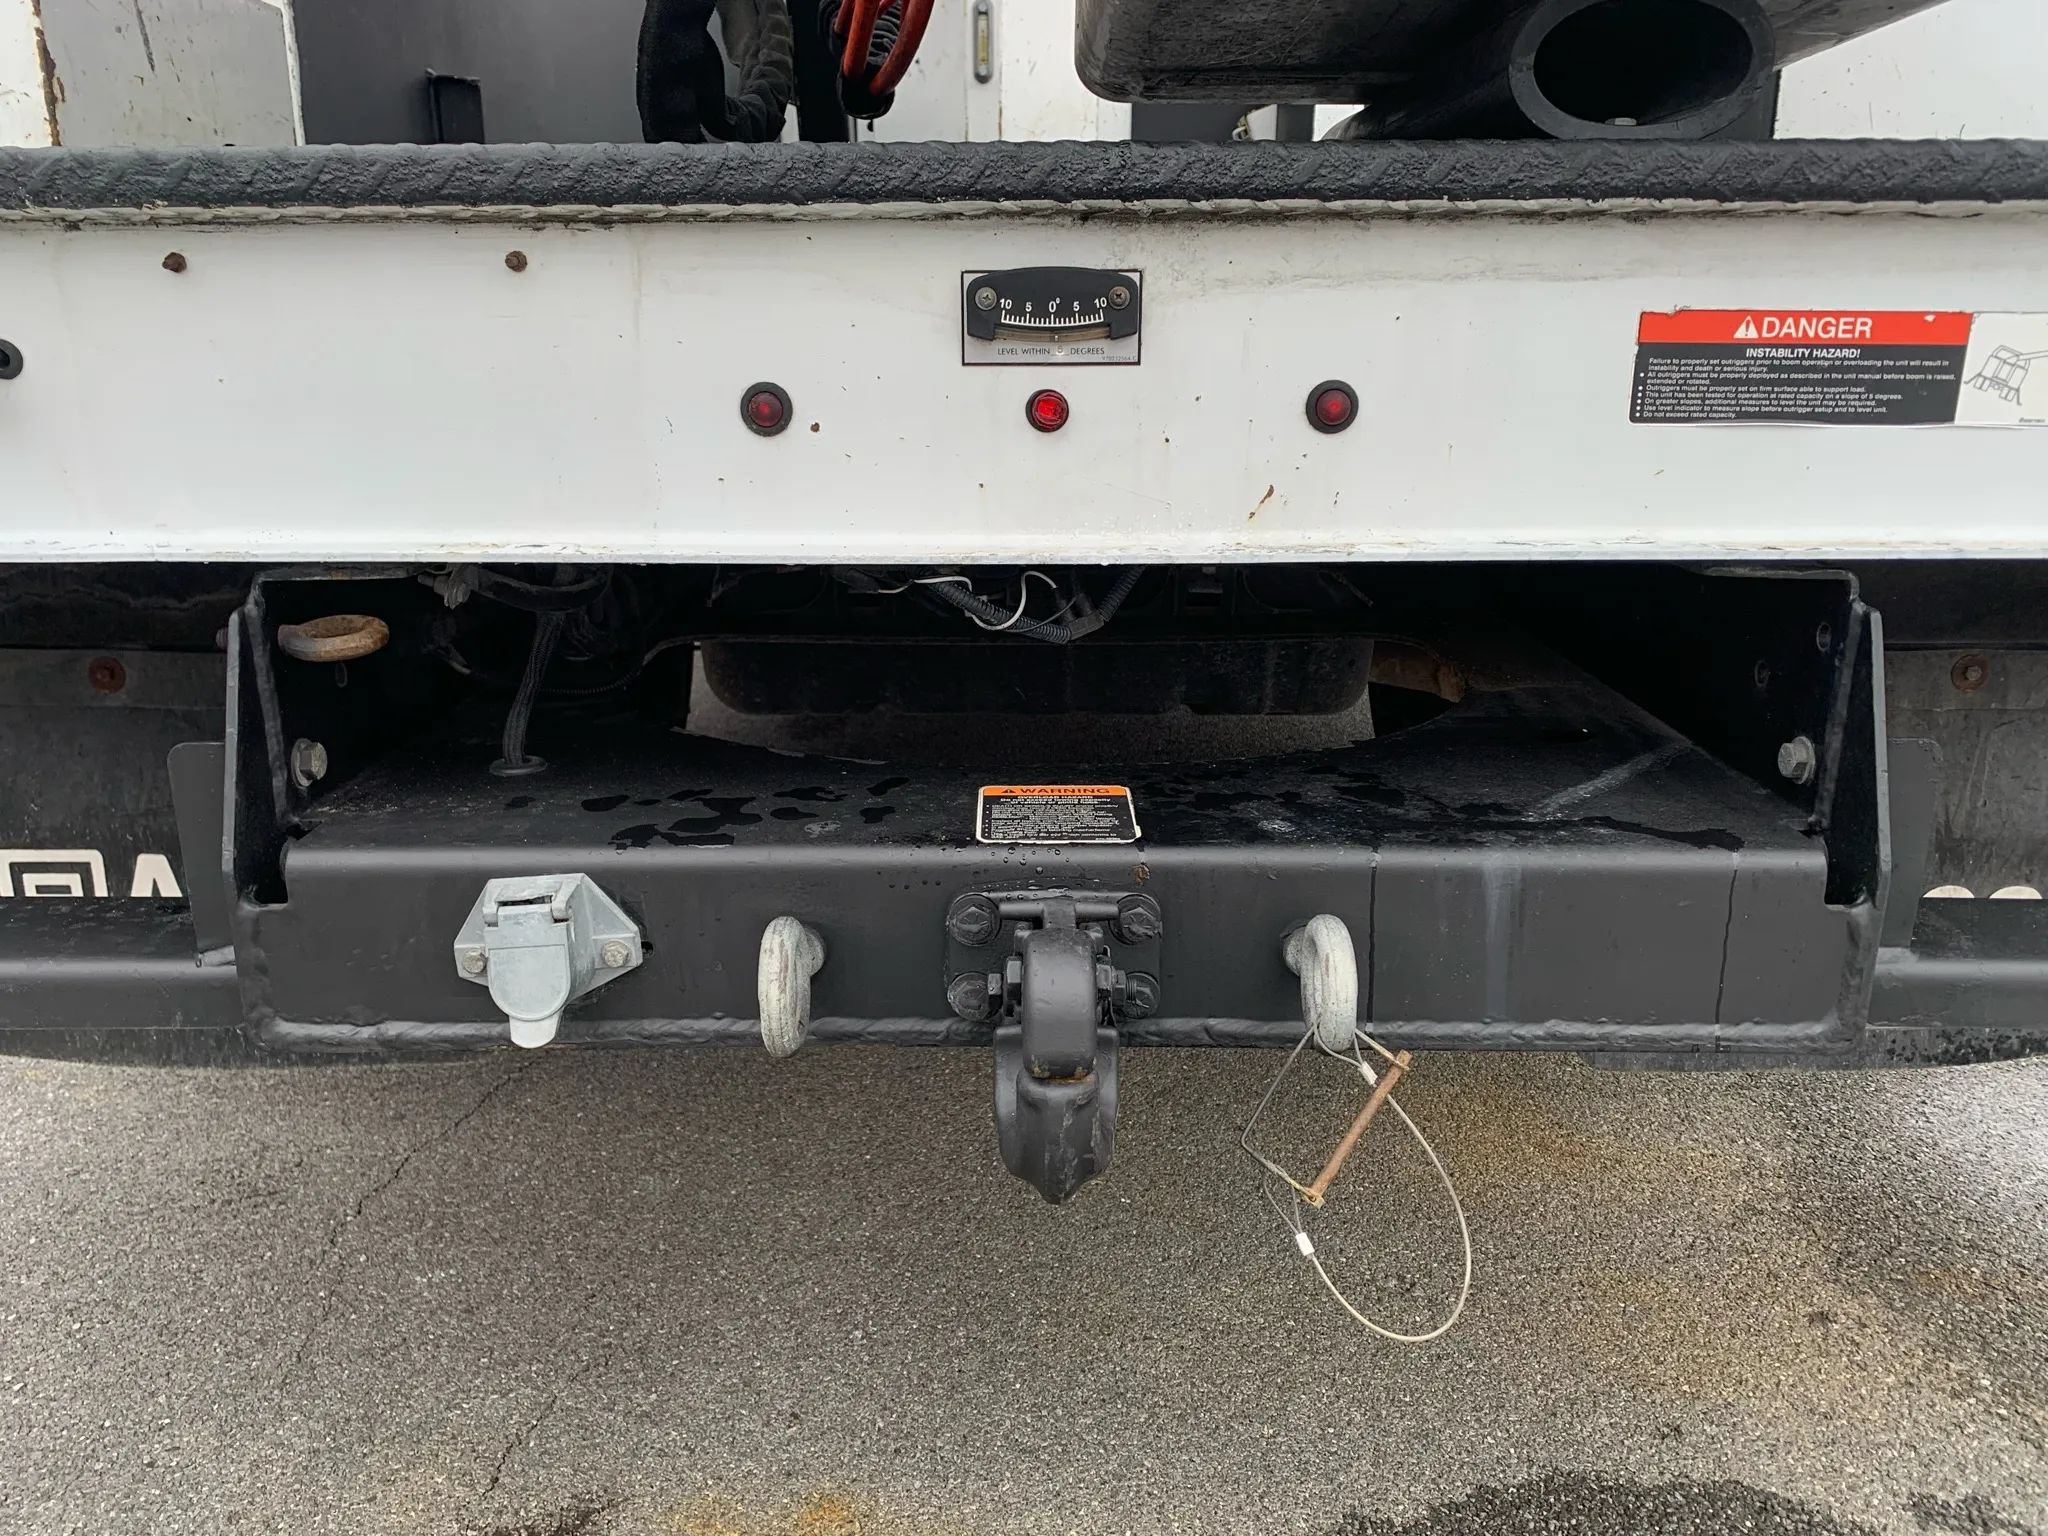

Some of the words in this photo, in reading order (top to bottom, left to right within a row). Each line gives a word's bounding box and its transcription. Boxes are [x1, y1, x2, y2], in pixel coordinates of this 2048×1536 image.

[1000, 298, 1012, 309] 10
[1026, 302, 1032, 312] 5
[1074, 301, 1080, 311] 5
[1094, 297, 1107, 308] 10
[1761, 316, 1873, 338] DANGER
[1746, 348, 1811, 357] INSTABILITY
[1813, 349, 1861, 358] HAZARD!
